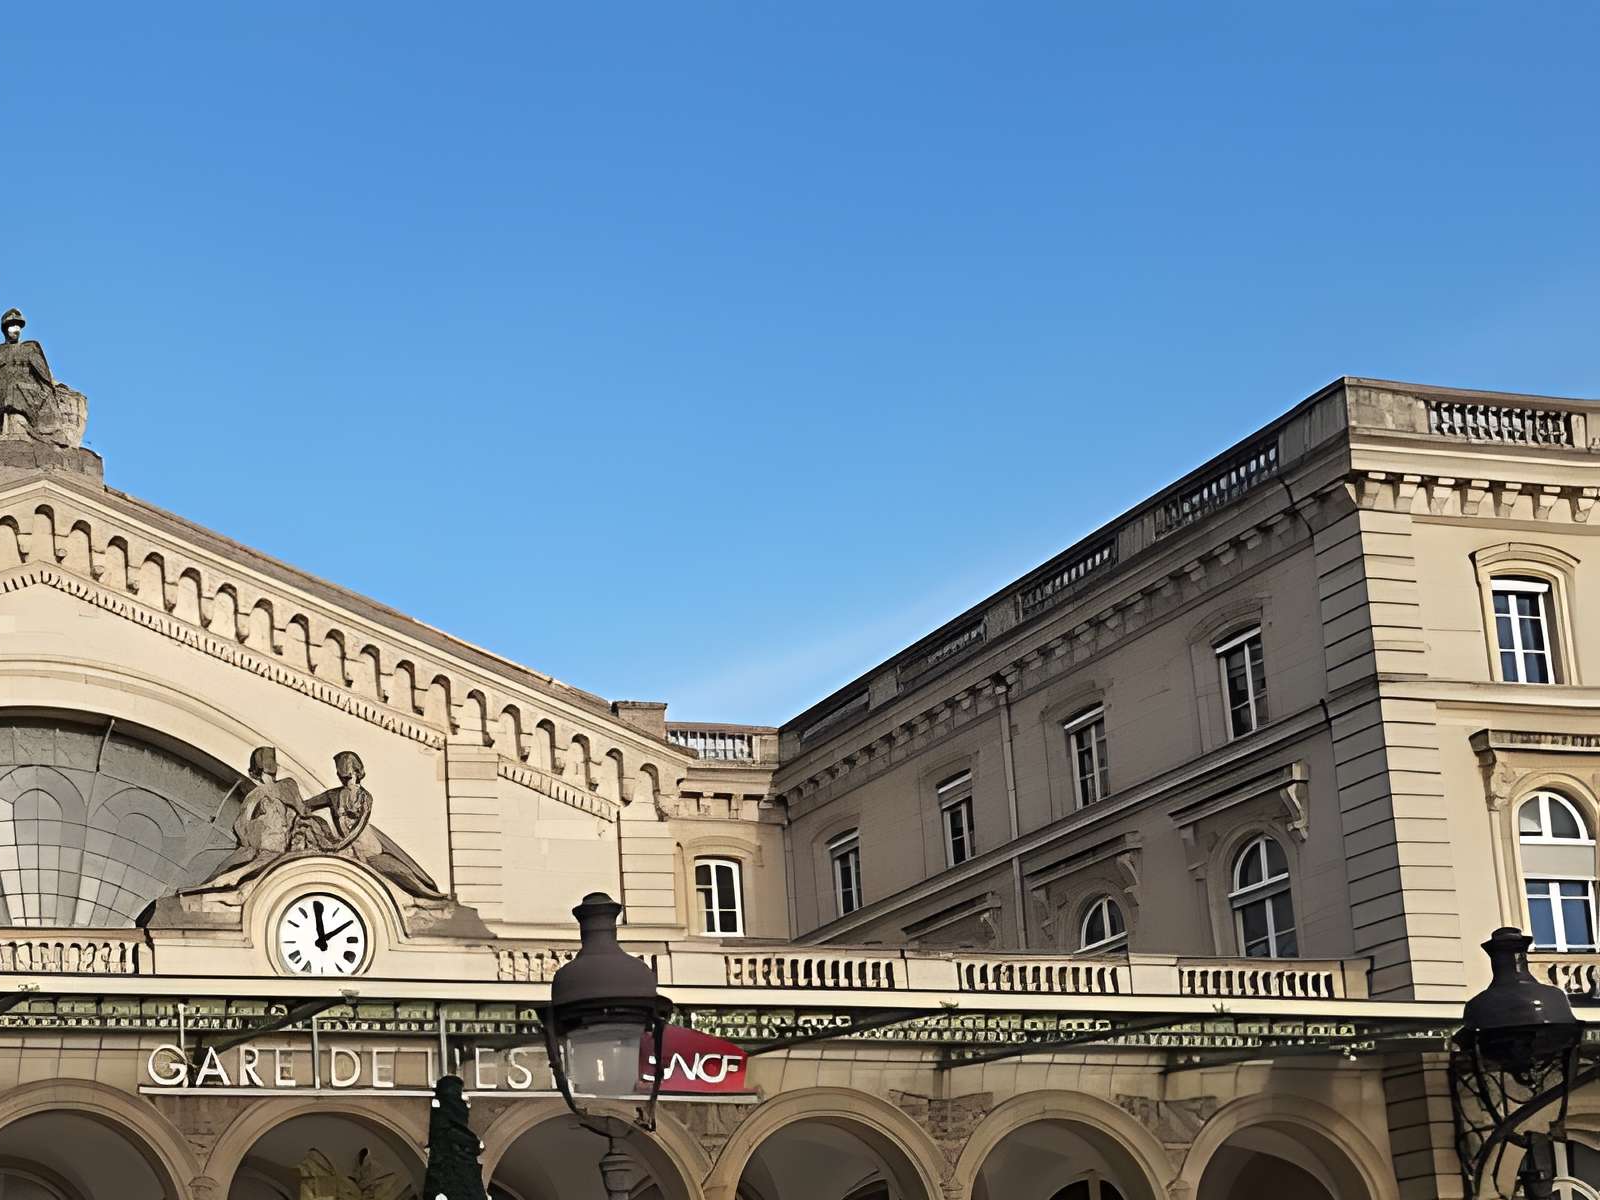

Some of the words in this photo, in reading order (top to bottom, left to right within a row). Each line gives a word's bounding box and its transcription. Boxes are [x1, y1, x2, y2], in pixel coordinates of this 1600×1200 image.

[147, 1044, 297, 1087] GARE
[330, 1046, 395, 1088] DE
[642, 1052, 743, 1083] SNCF
